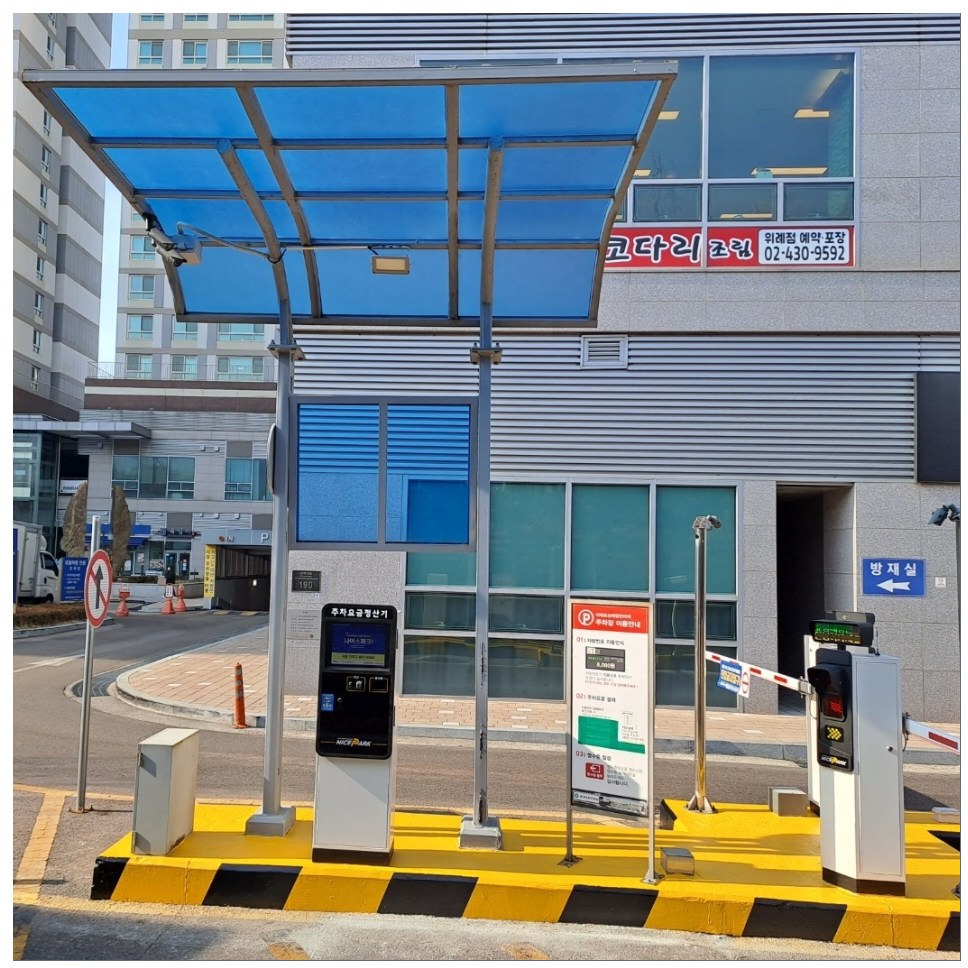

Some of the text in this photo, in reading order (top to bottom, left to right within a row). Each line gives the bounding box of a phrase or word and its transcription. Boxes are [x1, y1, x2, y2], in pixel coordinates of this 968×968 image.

[765, 231, 796, 245] 위례점
[607, 234, 755, 264] 코다리 조림
[765, 246, 845, 261] 02-430-9592
[260, 532, 270, 544] P
[299, 581, 313, 589] 190
[331, 607, 389, 619] 주차요금정산기
[595, 618, 642, 629] 주차장 이용안내
[335, 738, 373, 748] NICEPARK
